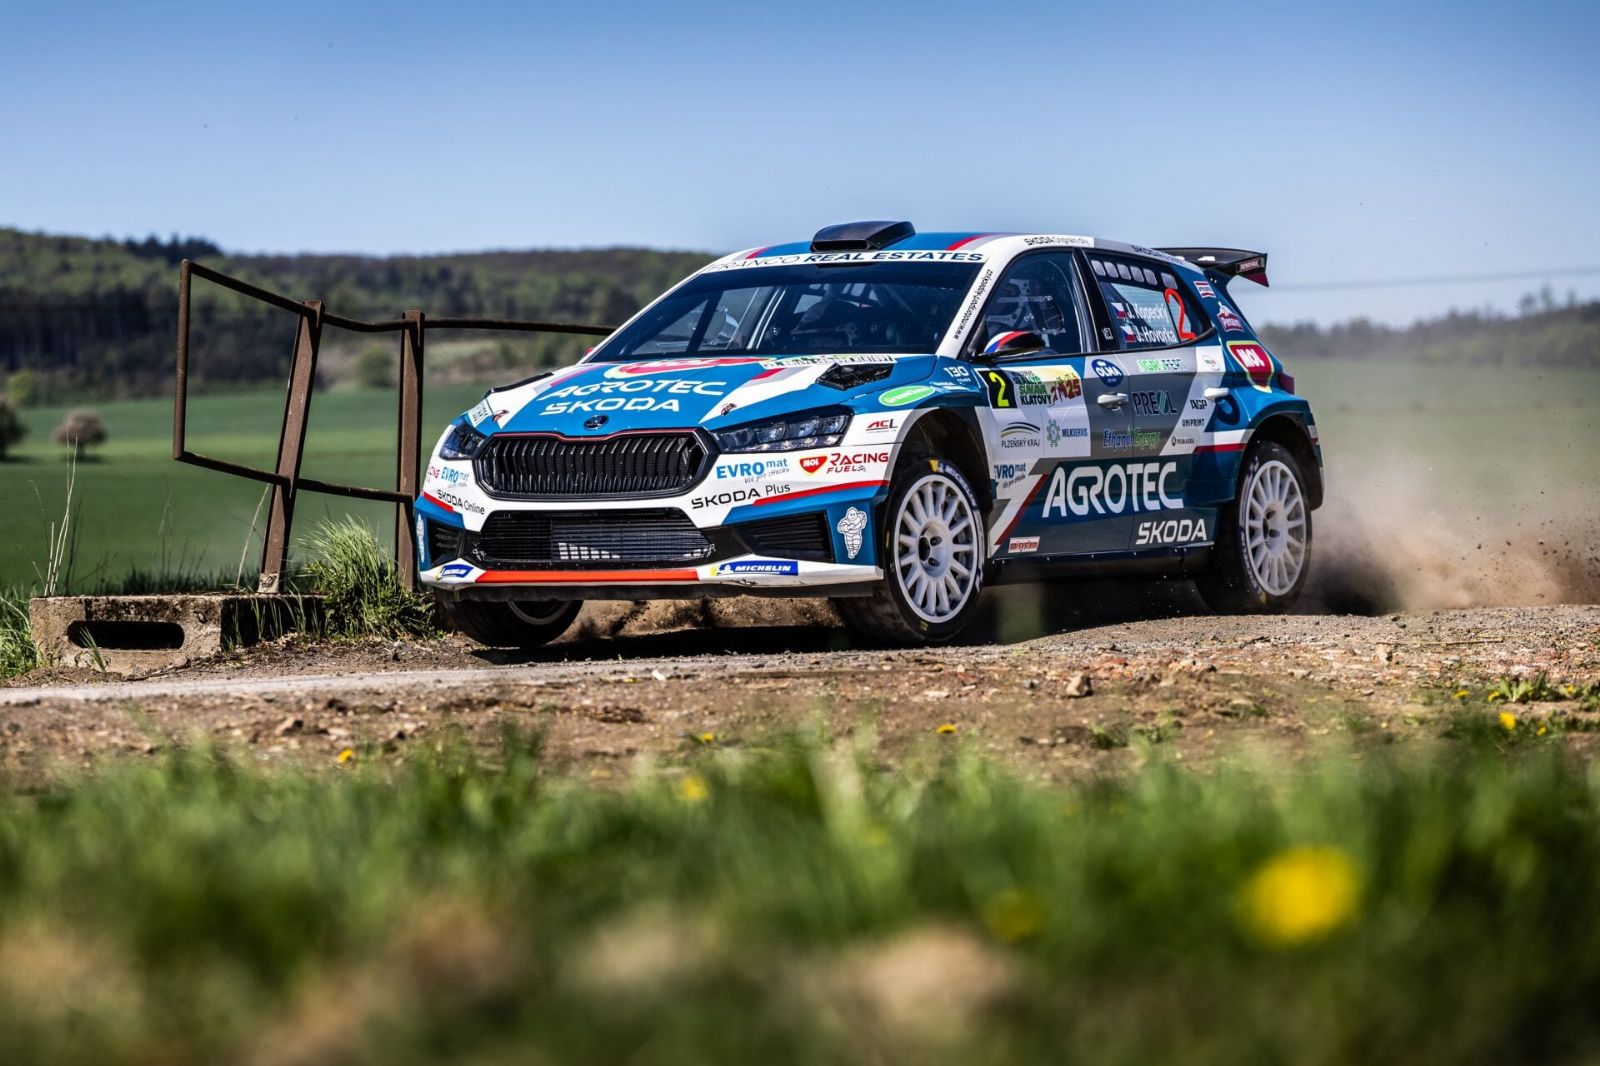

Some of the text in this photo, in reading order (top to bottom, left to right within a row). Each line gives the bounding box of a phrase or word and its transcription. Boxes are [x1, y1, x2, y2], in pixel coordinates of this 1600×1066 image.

[804, 253, 865, 263] REAL
[872, 251, 986, 262] ESTATES
[1164, 288, 1196, 340] 2
[1141, 326, 1178, 344] Hovorka
[943, 366, 969, 378] 130
[1096, 366, 1123, 377] OLMA
[537, 380, 727, 402] AGROTEC
[988, 371, 1010, 407] 2
[1020, 394, 1052, 406] KLATOVY
[1190, 399, 1208, 410] AGP
[867, 418, 899, 429] ACL
[1027, 438, 1041, 448] KRAJ
[828, 452, 889, 468] RACING
[765, 484, 791, 496] Plus
[1042, 463, 1184, 518] AGROTEC
[463, 500, 486, 515] Online
